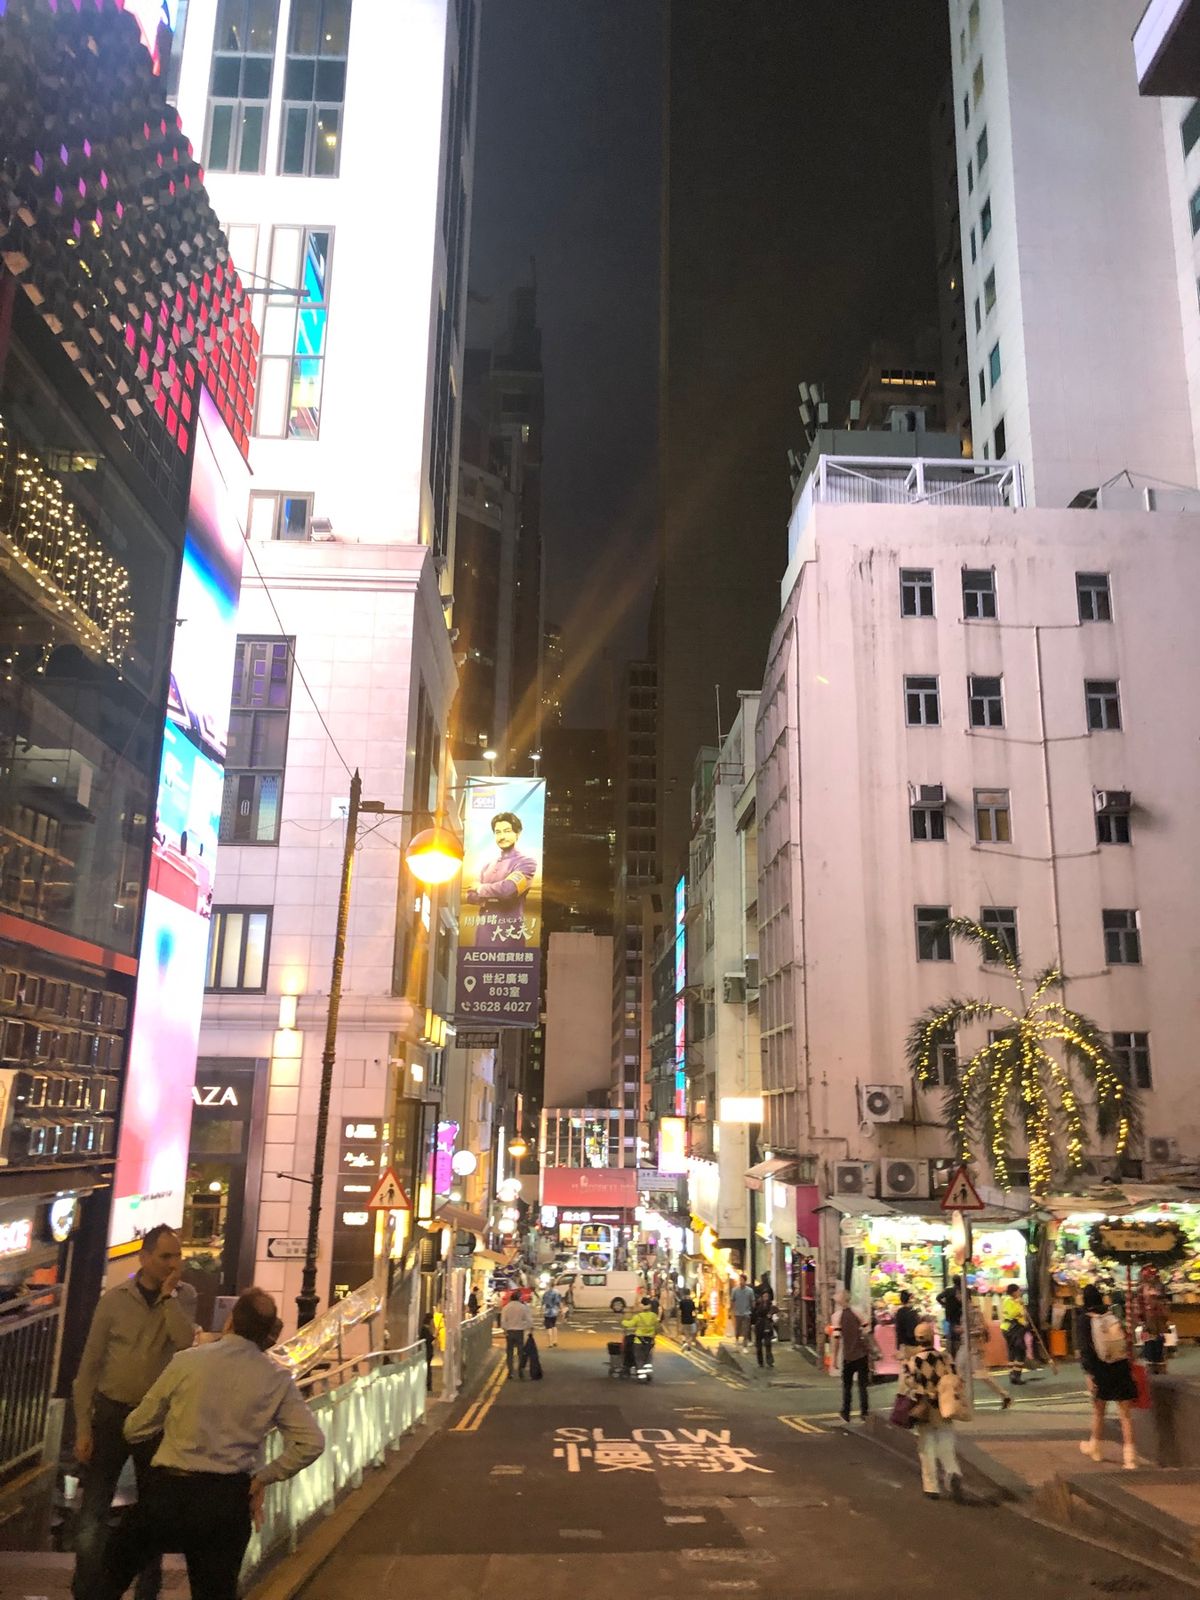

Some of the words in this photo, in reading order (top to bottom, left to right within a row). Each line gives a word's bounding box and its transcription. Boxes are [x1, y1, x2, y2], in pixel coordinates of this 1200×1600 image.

[482, 972, 529, 985] 世紀廣場
[489, 986, 521, 998] 803室
[472, 1001, 501, 1012] 3628
[503, 1001, 532, 1012] 4027
[553, 1427, 731, 1443] SLOW
[553, 1443, 775, 1473] 慢駛
